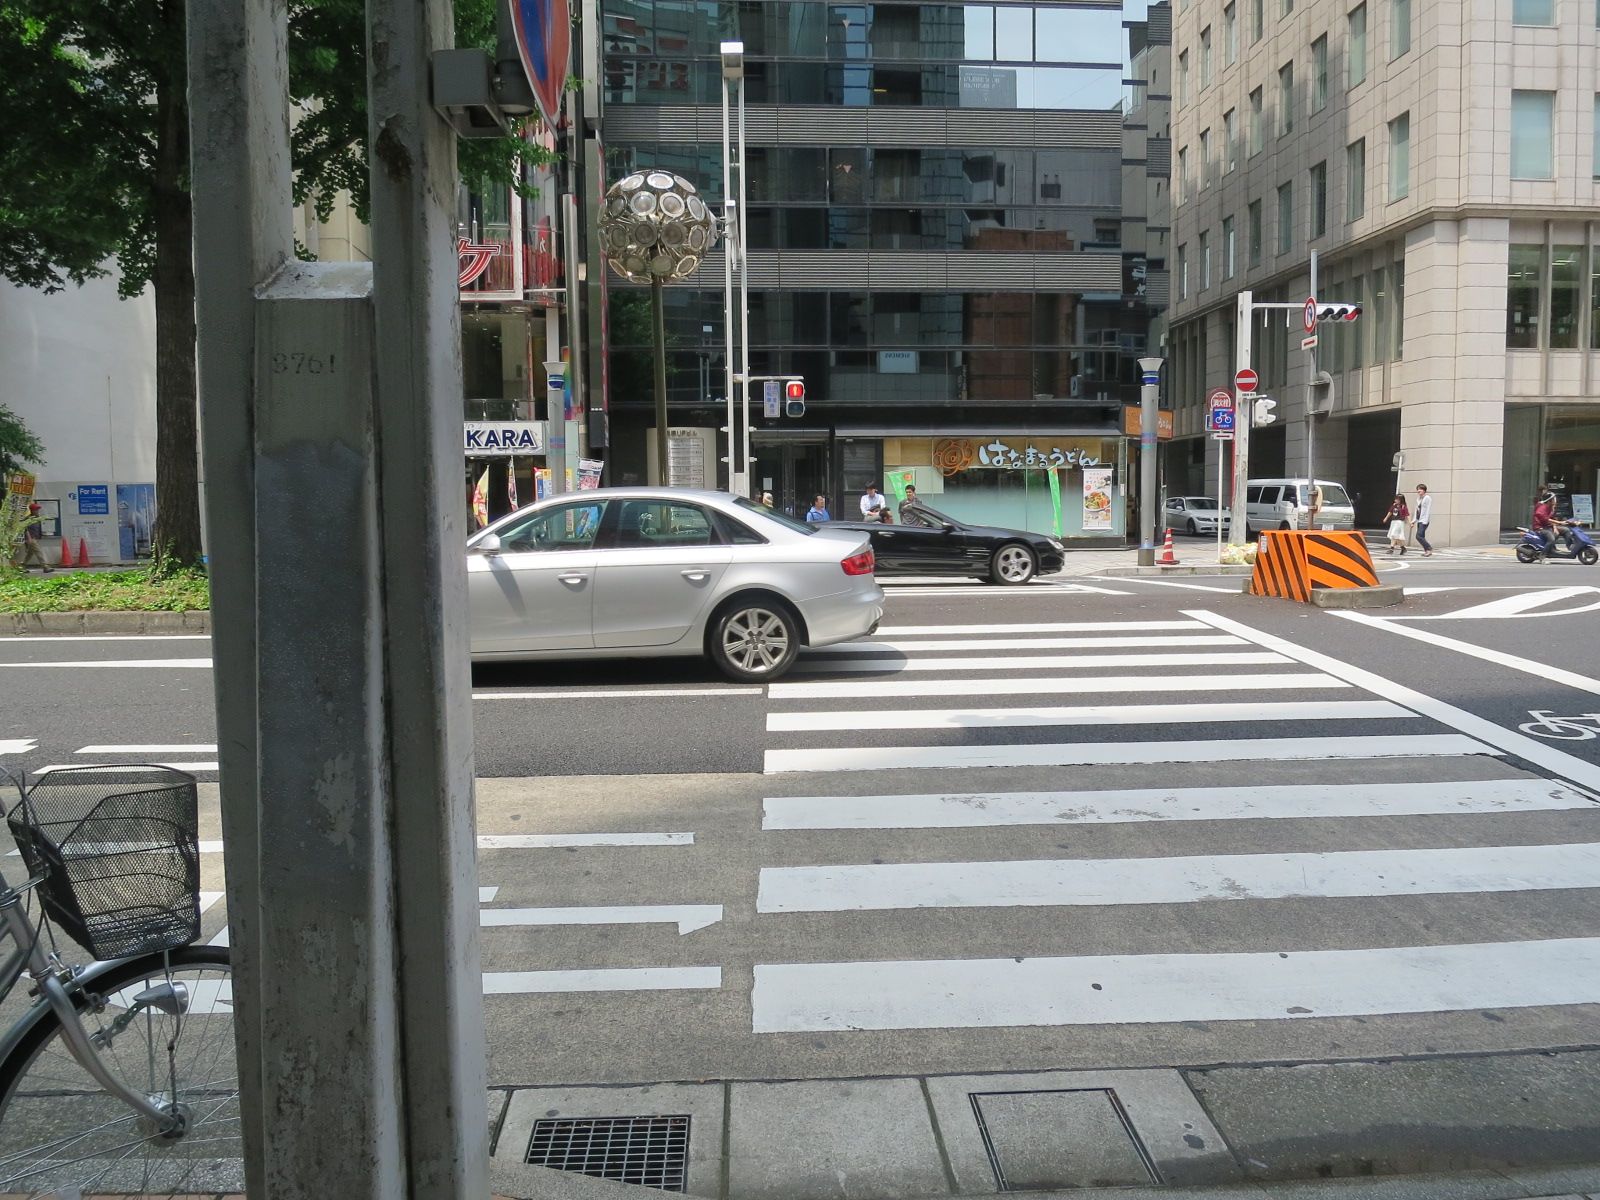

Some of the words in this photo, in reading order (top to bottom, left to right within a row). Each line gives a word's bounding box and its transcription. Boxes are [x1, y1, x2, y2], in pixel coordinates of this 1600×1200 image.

[465, 428, 535, 448] KARA
[978, 439, 1099, 468] はなまるうどん
[91, 487, 106, 495] Rent
